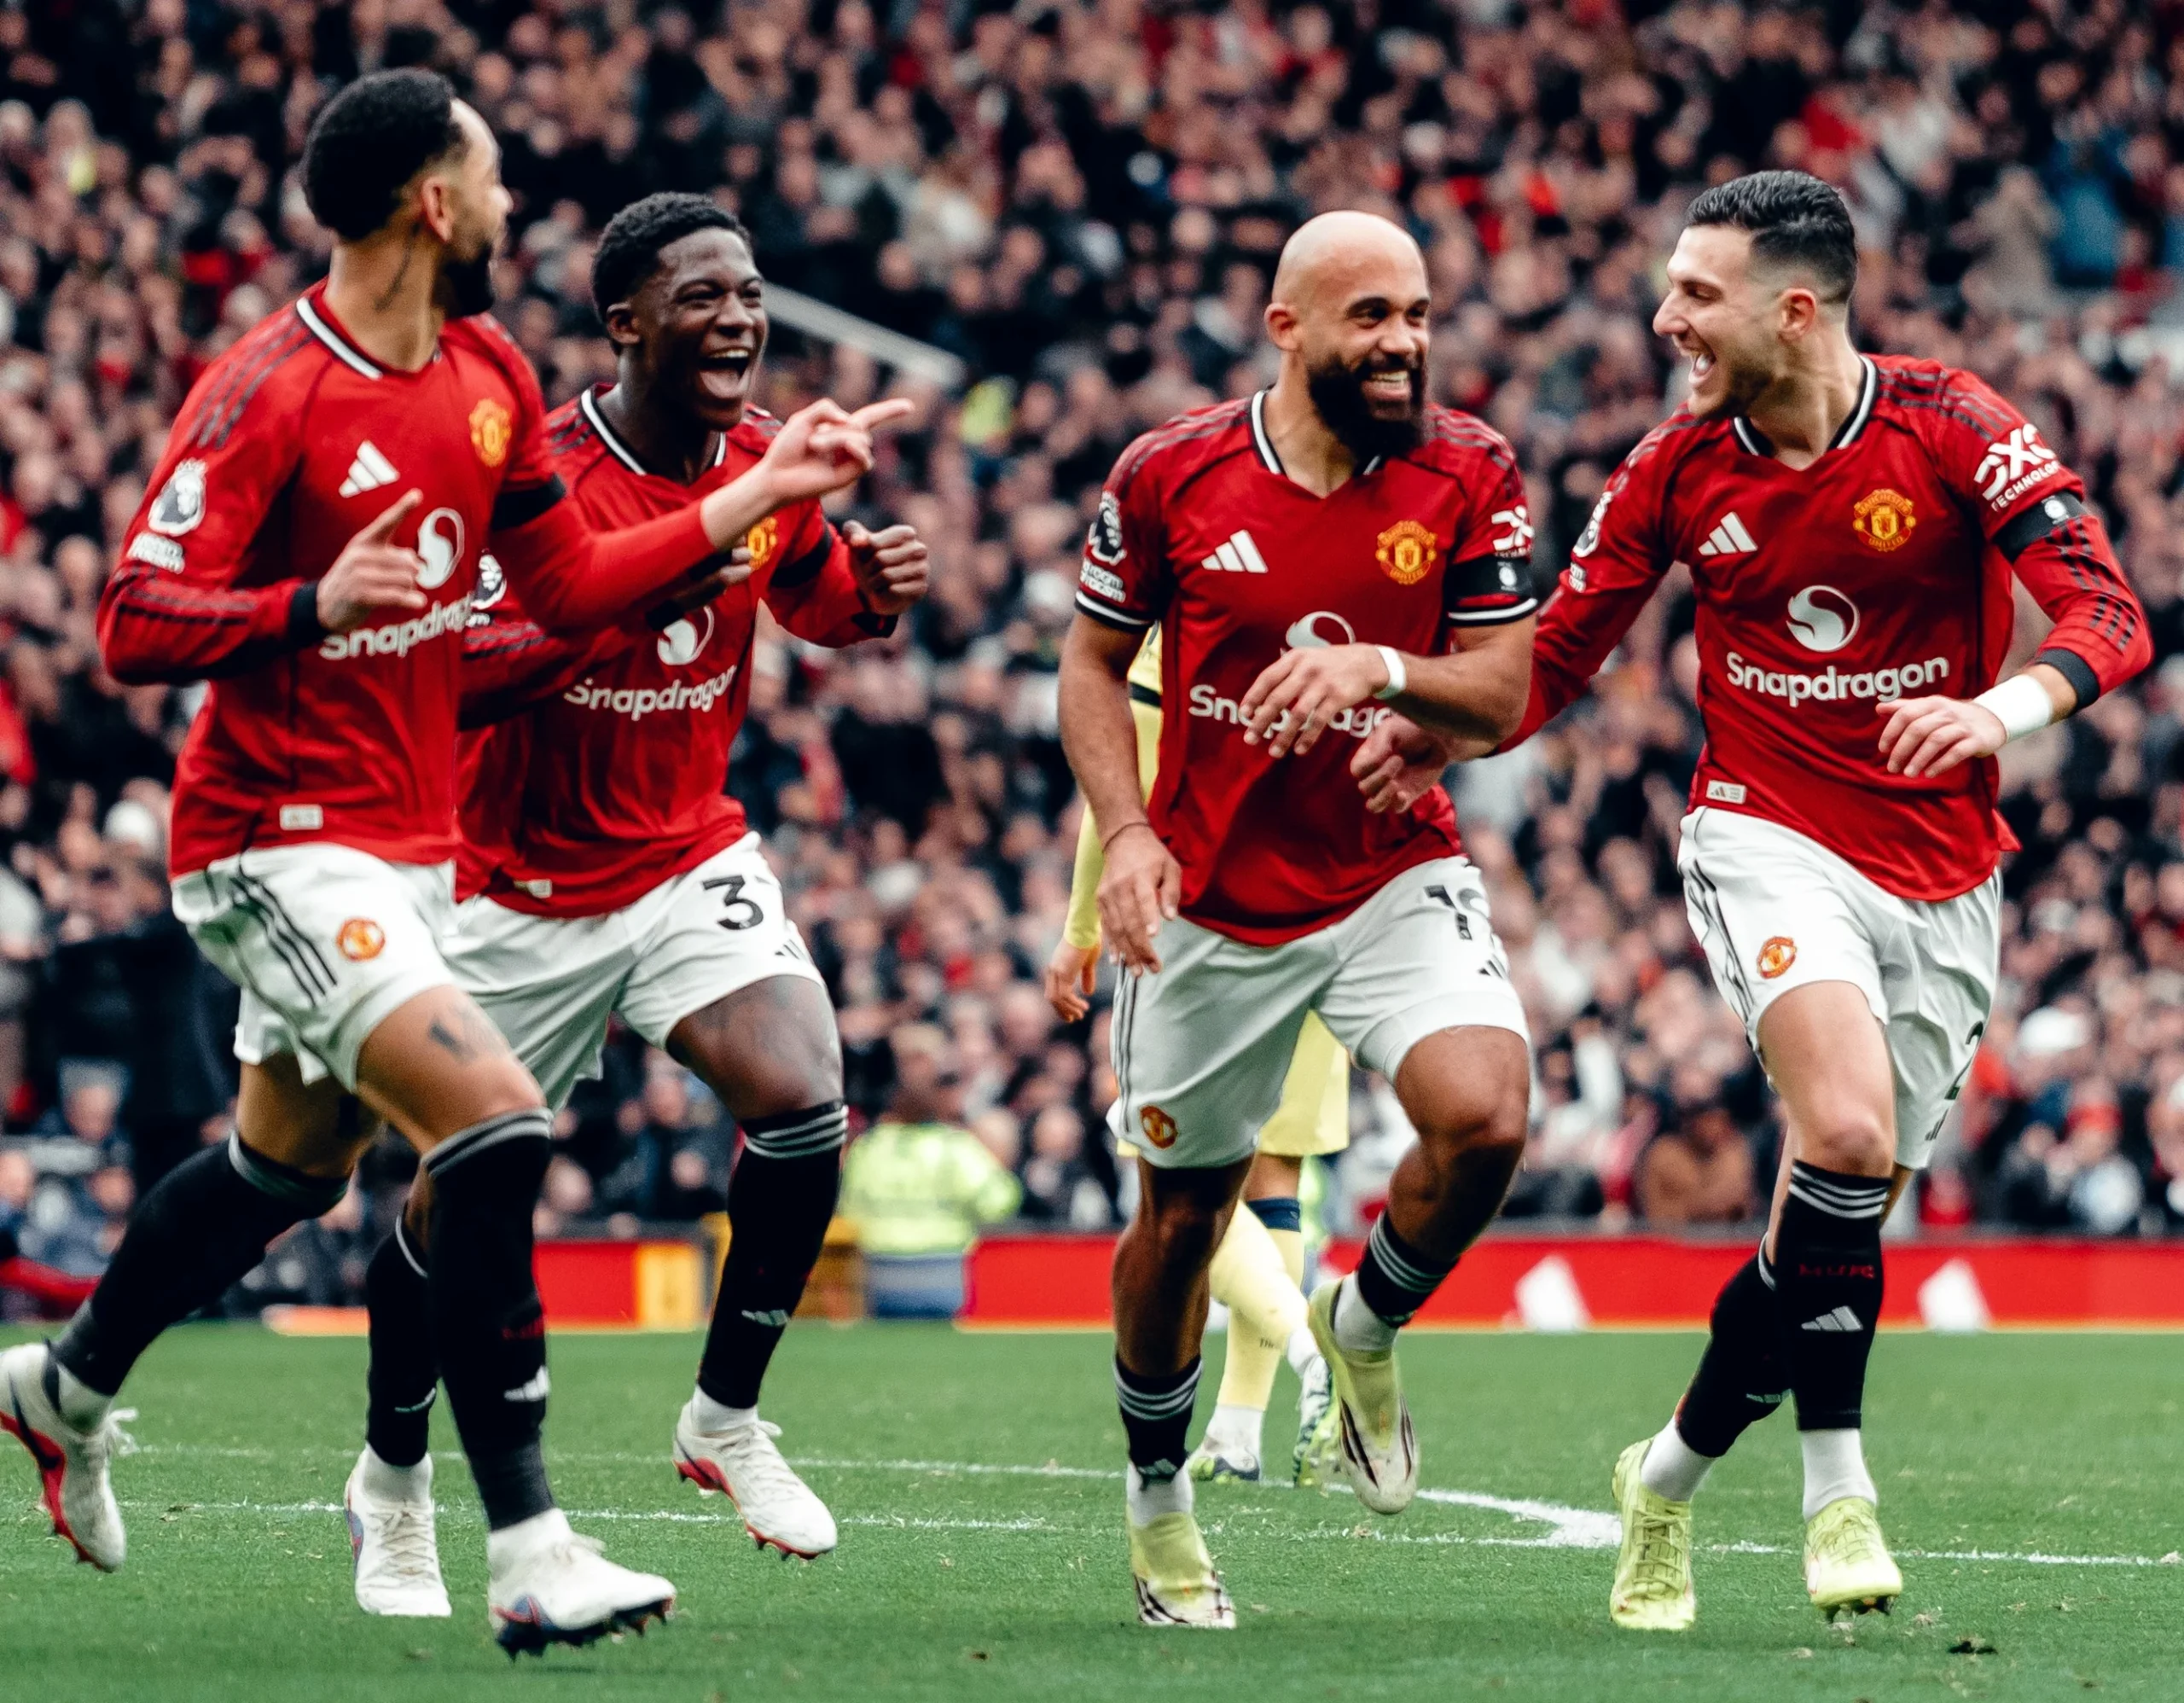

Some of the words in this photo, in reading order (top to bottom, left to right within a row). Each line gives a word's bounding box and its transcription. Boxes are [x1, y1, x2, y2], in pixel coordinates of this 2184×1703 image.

[1991, 460, 2059, 512] TECHNOLO
[1726, 650, 1950, 708] Snapdragon
[701, 874, 772, 931] 3
